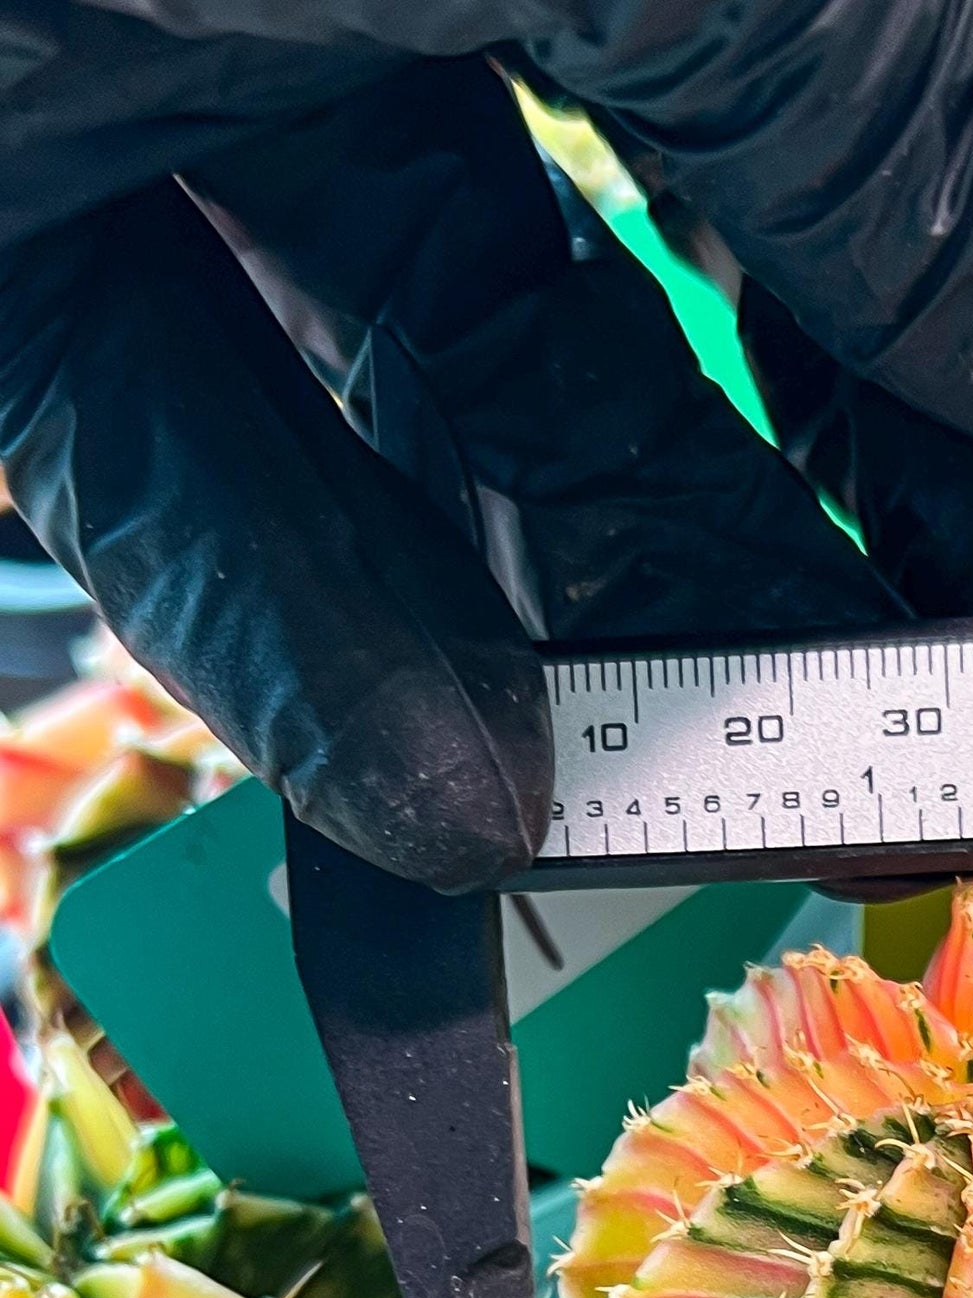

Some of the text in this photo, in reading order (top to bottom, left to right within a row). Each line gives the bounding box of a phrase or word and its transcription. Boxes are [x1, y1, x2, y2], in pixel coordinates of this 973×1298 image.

[581, 722, 628, 753] 10
[724, 714, 784, 746] 20
[882, 707, 943, 737] 30
[586, 800, 604, 817] 3
[626, 799, 642, 816] 4
[665, 796, 681, 815] 5
[703, 795, 721, 813] 6
[746, 793, 761, 810] 7
[782, 791, 801, 809] 8
[821, 789, 840, 808] 9
[860, 765, 874, 795] 1
[909, 785, 918, 803] 1
[940, 783, 958, 802] 2
